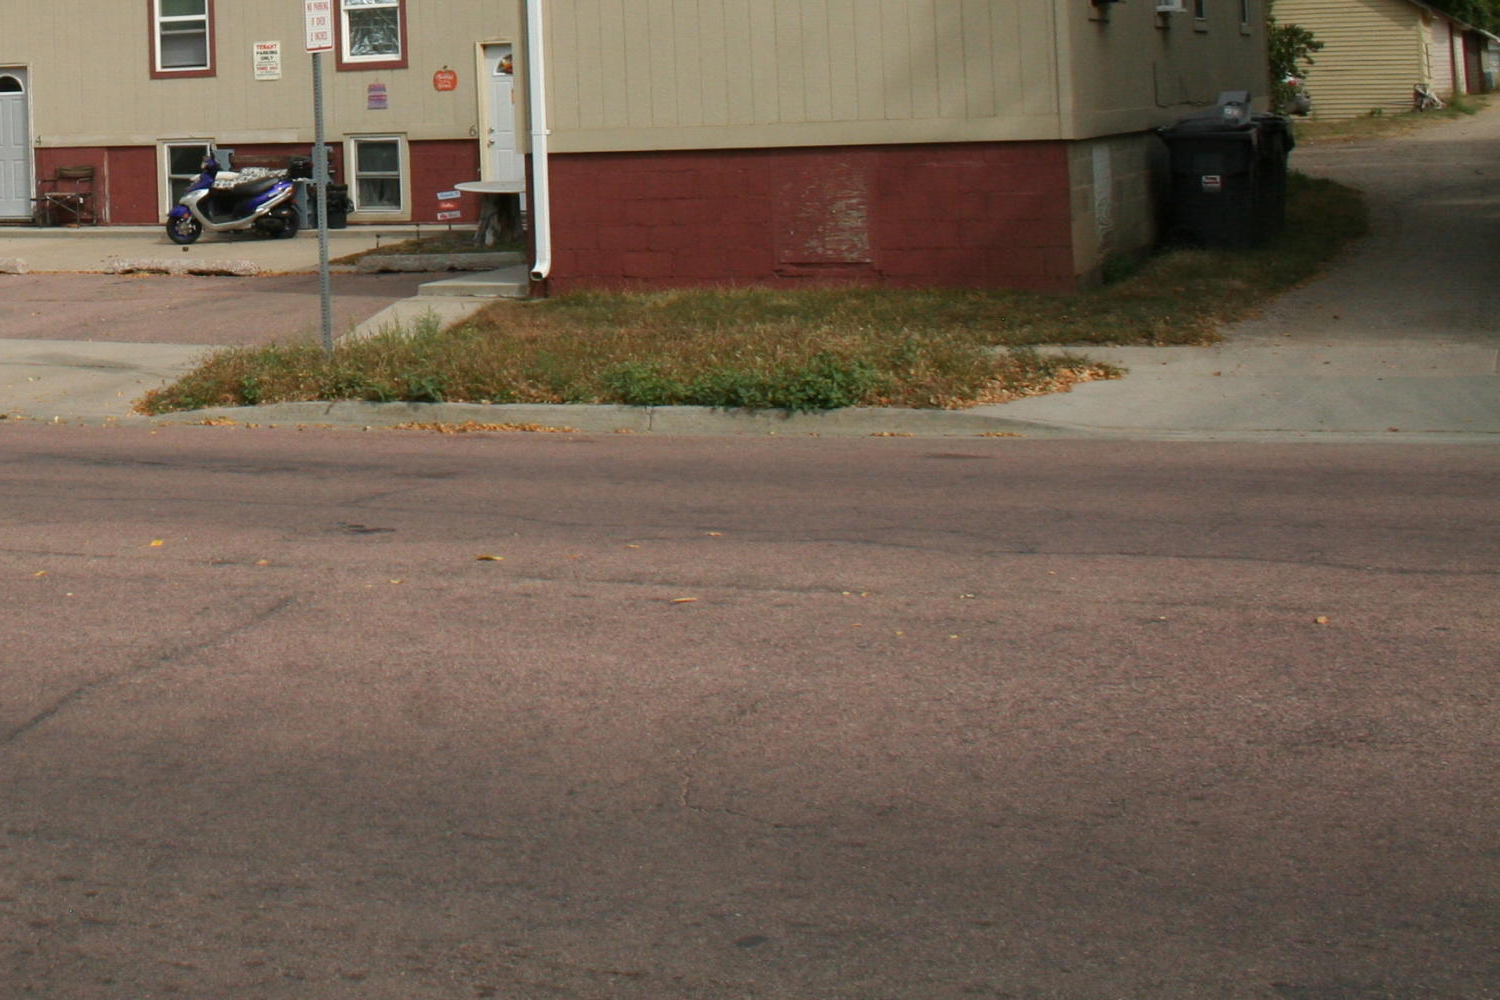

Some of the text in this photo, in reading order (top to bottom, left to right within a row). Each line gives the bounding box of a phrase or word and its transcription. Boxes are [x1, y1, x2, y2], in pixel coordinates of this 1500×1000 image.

[307, 1, 328, 11] NO PARKING
[469, 125, 477, 137] 6
